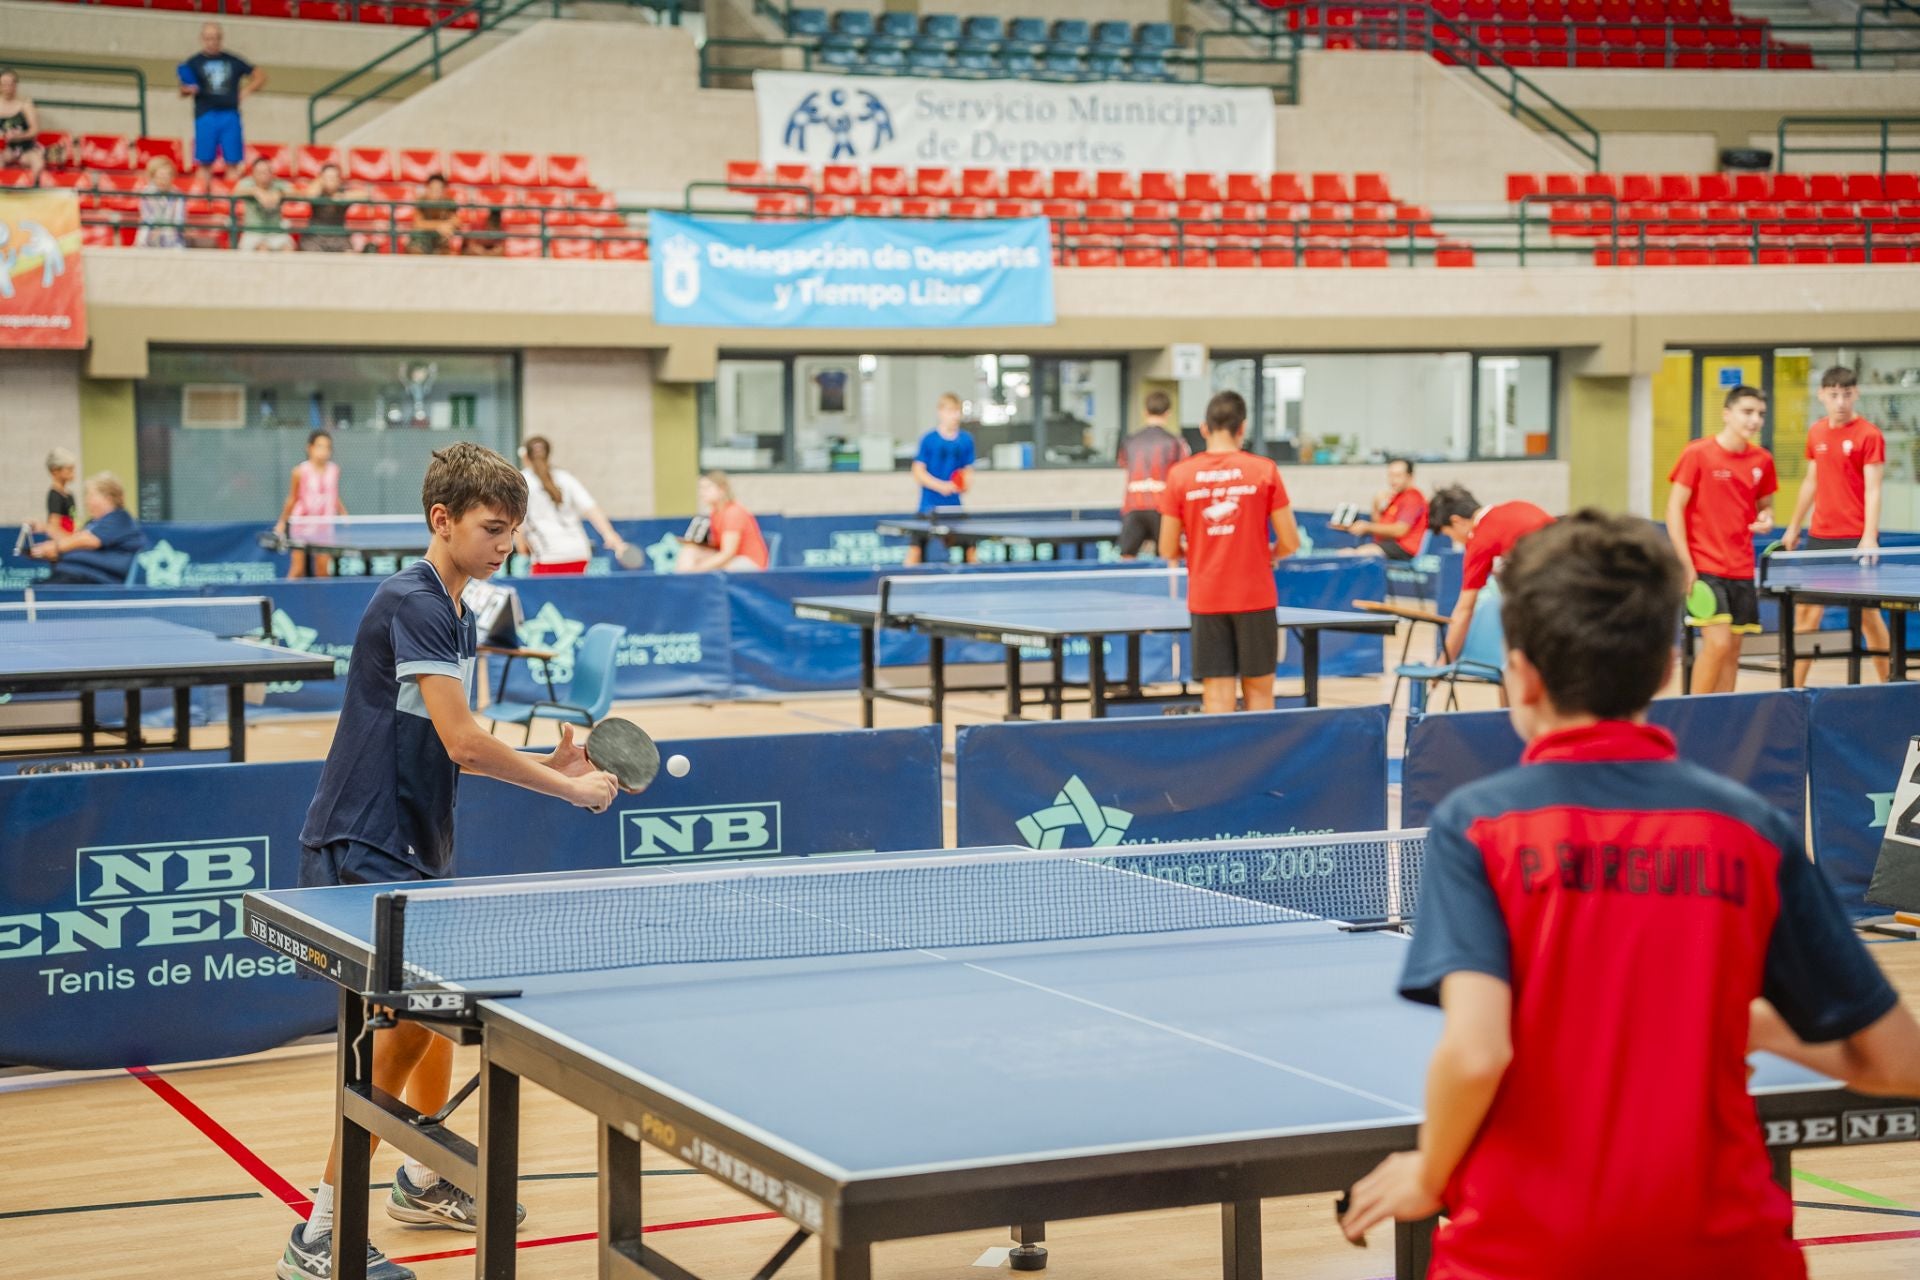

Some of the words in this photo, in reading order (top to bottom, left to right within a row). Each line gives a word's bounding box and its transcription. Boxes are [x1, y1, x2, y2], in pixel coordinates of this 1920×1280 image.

[914, 89, 1056, 123] Servicio
[1068, 94, 1237, 135] Municipal
[917, 129, 960, 160] de
[971, 130, 1126, 169] Deportes
[707, 241, 869, 275] Delegación
[872, 243, 911, 270] de
[913, 246, 1040, 275] Deportes
[773, 283, 794, 310] y
[797, 276, 906, 310] Tiempo
[909, 279, 983, 305] Libre
[652, 642, 702, 664] 2005
[631, 811, 769, 856] NB
[89, 846, 255, 897] NB
[1261, 847, 1334, 881] 2005
[251, 918, 267, 940] NB
[268, 926, 308, 961] ENEBE
[307, 947, 328, 970] PRO
[39, 964, 136, 996] Tenis
[148, 959, 192, 986] de
[204, 952, 297, 982] Mesa
[409, 994, 464, 1011] NB
[1849, 1112, 1917, 1138] NB
[642, 1112, 677, 1148] PRO
[700, 1141, 786, 1210] ENEBE
